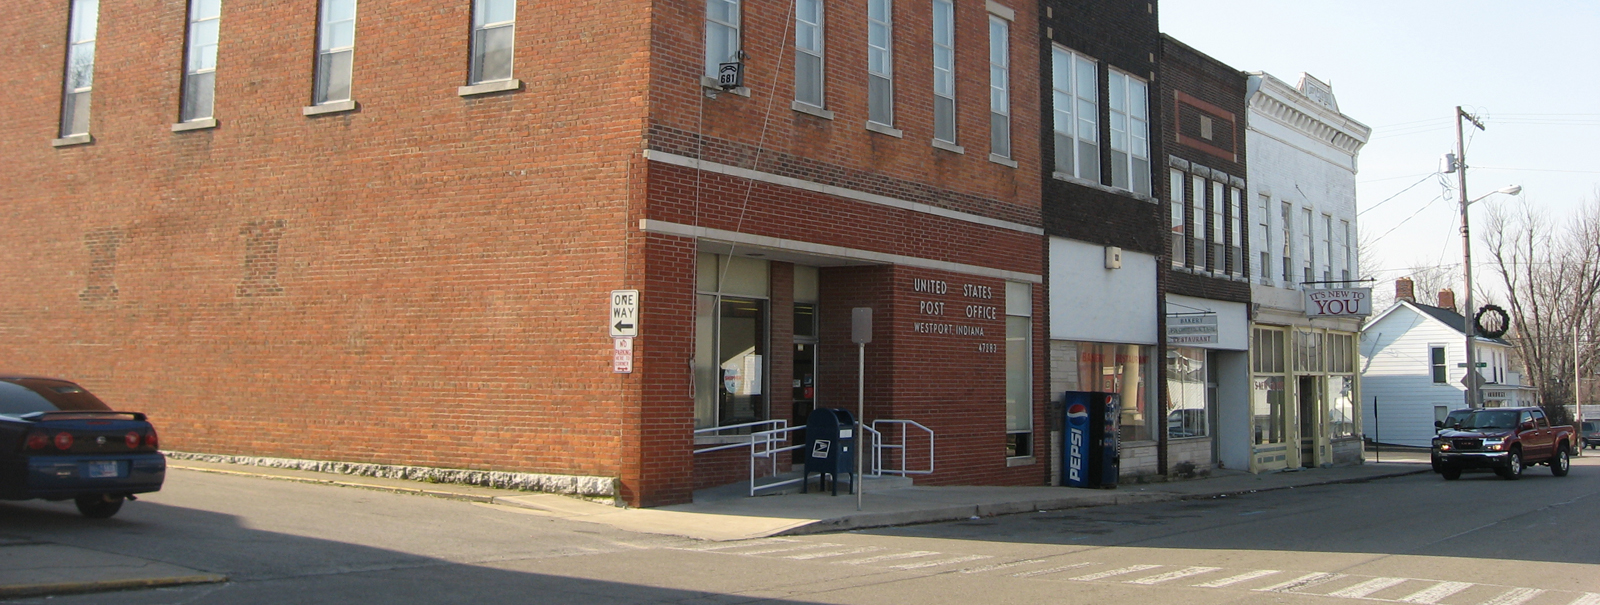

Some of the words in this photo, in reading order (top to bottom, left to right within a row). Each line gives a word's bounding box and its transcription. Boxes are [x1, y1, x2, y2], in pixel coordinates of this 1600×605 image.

[720, 74, 735, 84] 681
[914, 278, 947, 295] UNITED
[963, 284, 992, 299] STATES
[614, 294, 634, 306] ONE
[1309, 291, 1326, 301] IT'S
[1328, 290, 1350, 298] NEW
[1351, 291, 1365, 300] TO
[613, 307, 634, 319] WAY
[920, 300, 945, 315] POST
[965, 305, 997, 320] OFFICE
[1313, 299, 1360, 315] YOU
[955, 325, 985, 337] INDIANA
[1069, 428, 1082, 482] PEPSI
